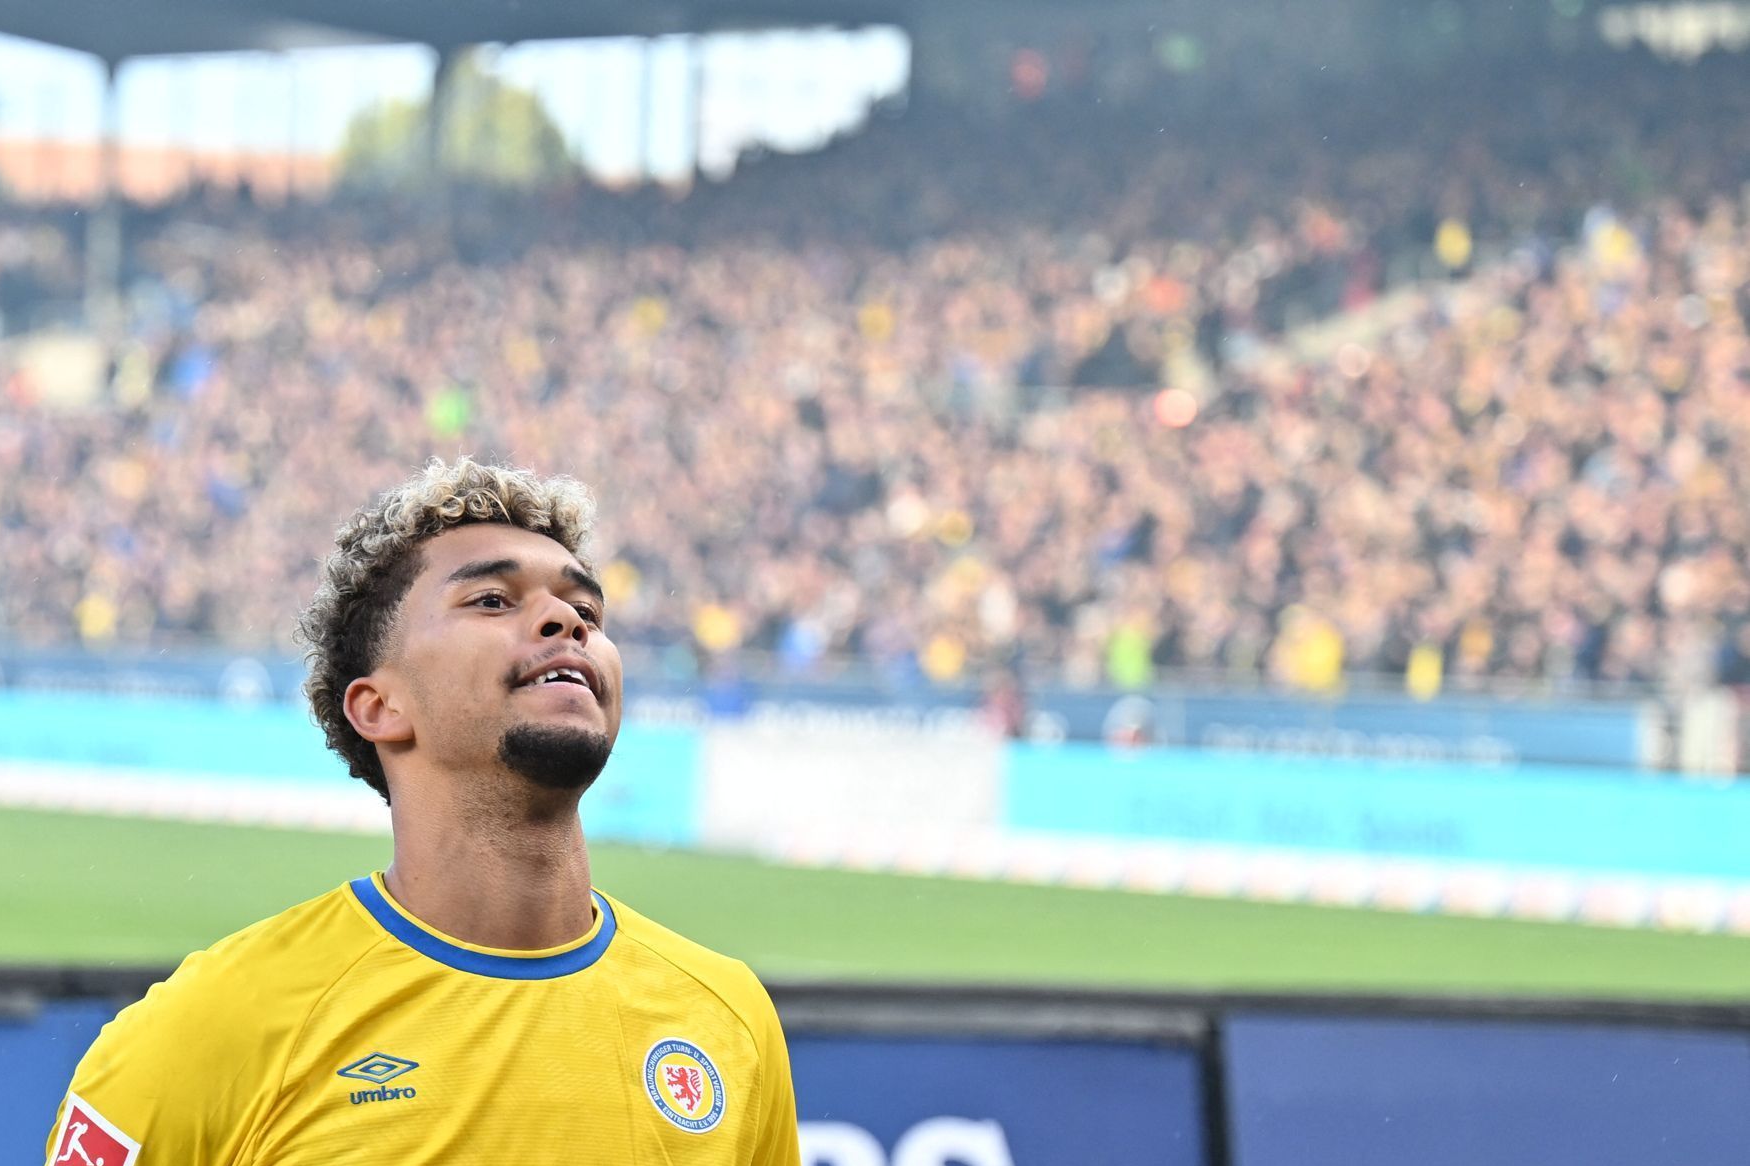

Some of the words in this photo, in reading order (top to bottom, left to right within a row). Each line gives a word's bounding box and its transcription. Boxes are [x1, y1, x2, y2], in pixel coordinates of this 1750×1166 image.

[647, 1044, 672, 1103] BRAUNSCHWEIGER
[672, 1044, 693, 1054] TURN-
[700, 1058, 723, 1107] SPORTVEREIN
[350, 1085, 416, 1104] umbro
[662, 1106, 698, 1128] EINTRACHT
